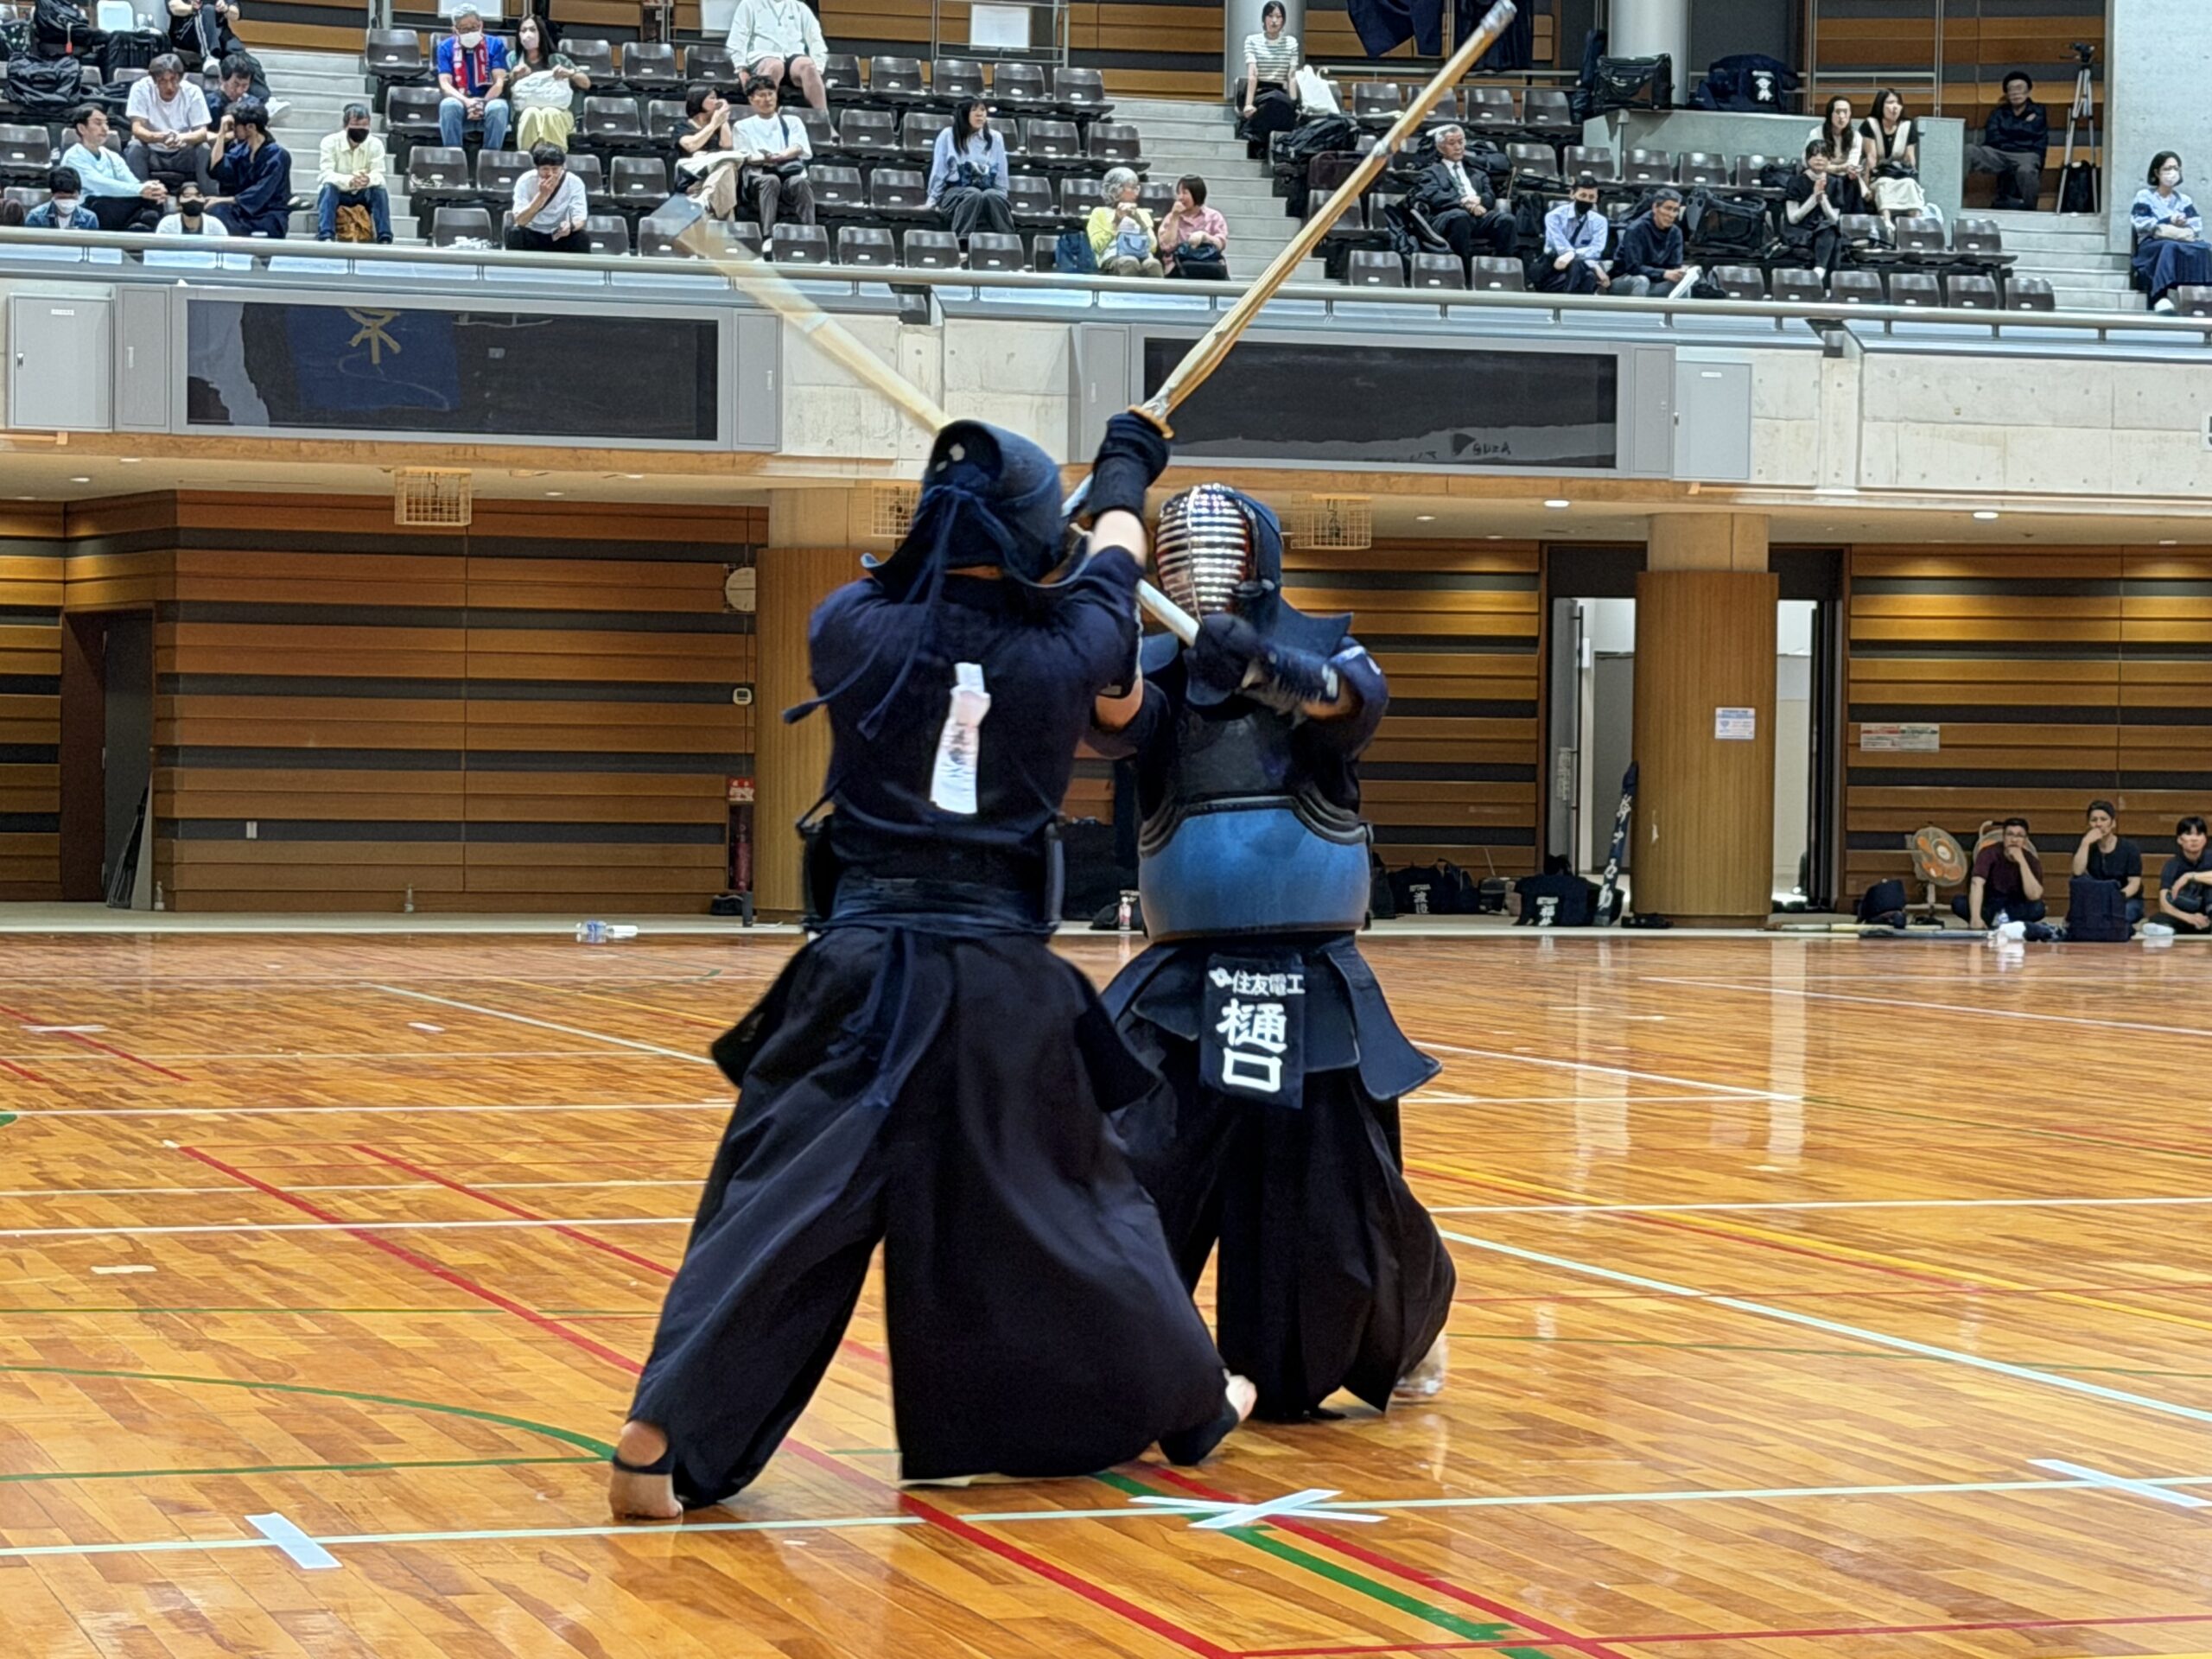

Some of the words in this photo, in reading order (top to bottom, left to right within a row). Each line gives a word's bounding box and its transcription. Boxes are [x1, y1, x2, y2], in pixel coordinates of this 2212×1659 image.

[1232, 969, 1306, 997] 住友電工
[1216, 998, 1287, 1093] 樋口
